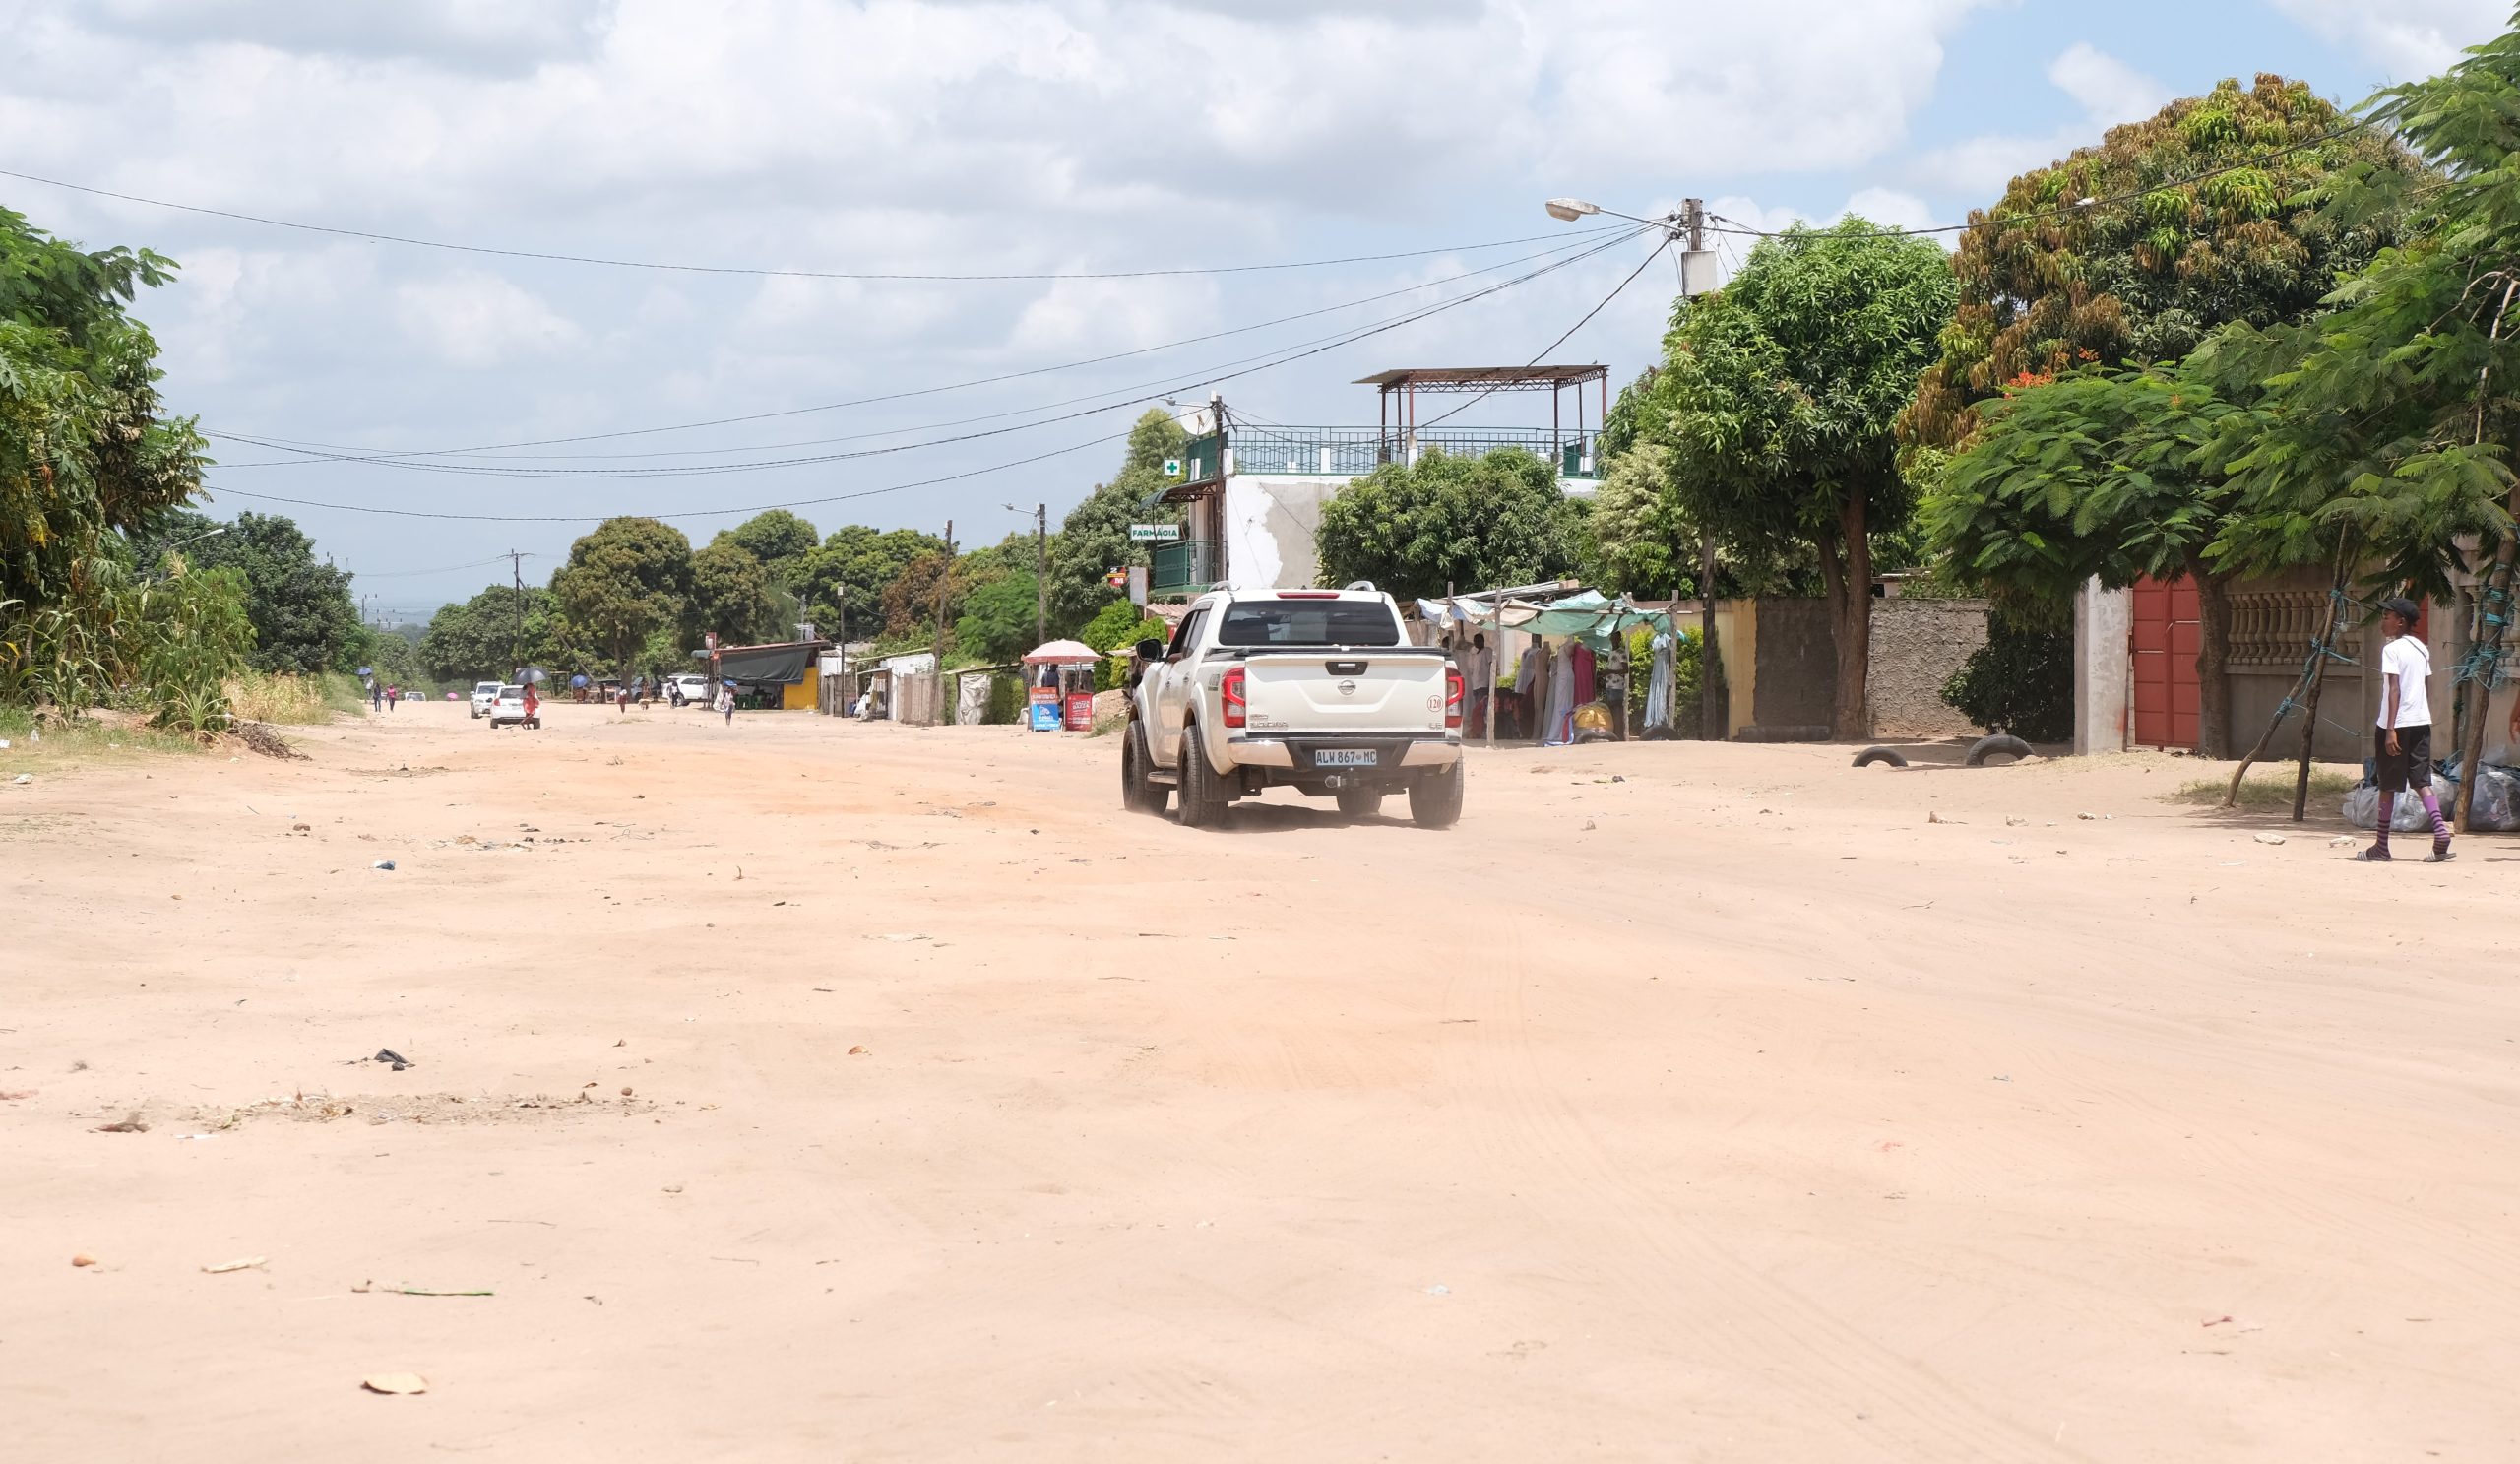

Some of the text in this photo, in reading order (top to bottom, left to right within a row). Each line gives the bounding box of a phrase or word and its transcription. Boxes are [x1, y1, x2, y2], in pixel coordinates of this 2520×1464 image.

[1429, 698, 1442, 709] 120
[1316, 751, 1376, 764] ALW 867 MC
